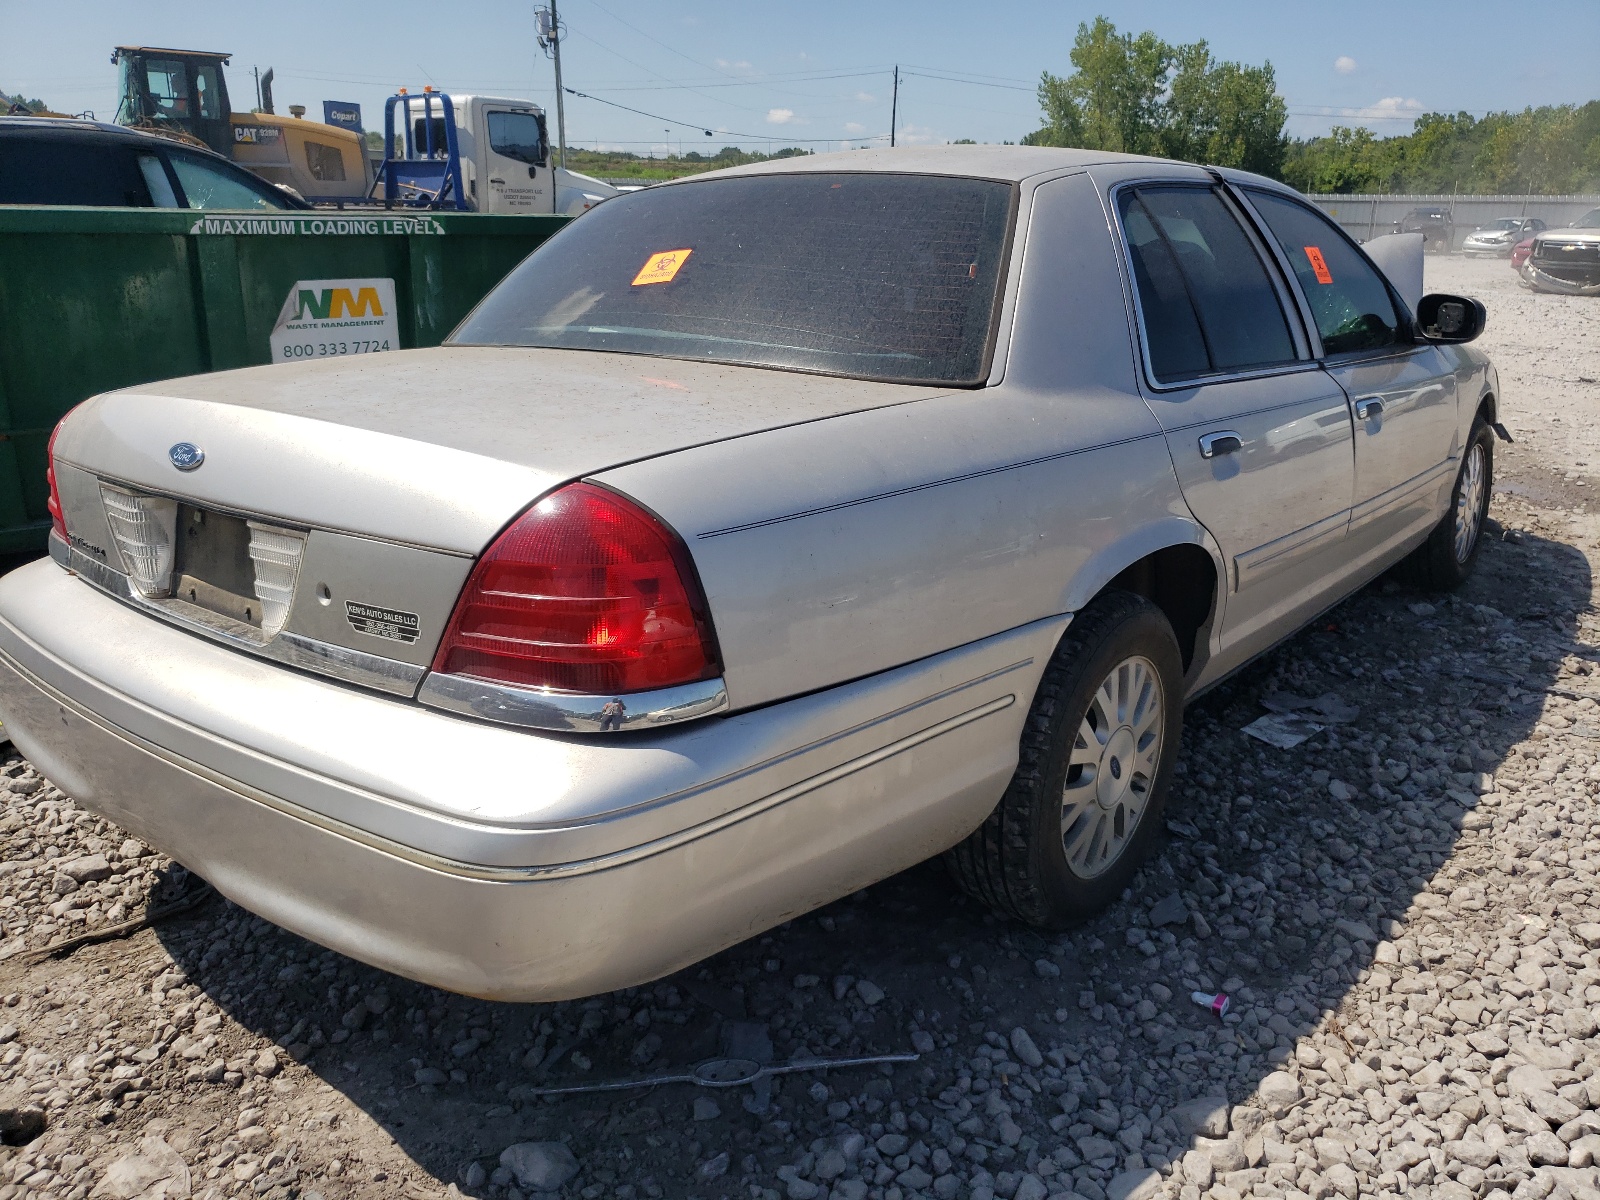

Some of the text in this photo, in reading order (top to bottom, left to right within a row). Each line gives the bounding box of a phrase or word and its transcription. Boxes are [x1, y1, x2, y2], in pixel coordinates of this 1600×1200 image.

[331, 110, 356, 121] Copart
[234, 127, 257, 142] CAT
[205, 219, 434, 235] MAXIMUM LOADING LEVEL
[321, 319, 385, 328] MANAGEMENT
[283, 339, 391, 358] 800 333 7724
[173, 446, 192, 462] Ford
[348, 604, 417, 626] KEN'S AUTO SALES LLC
